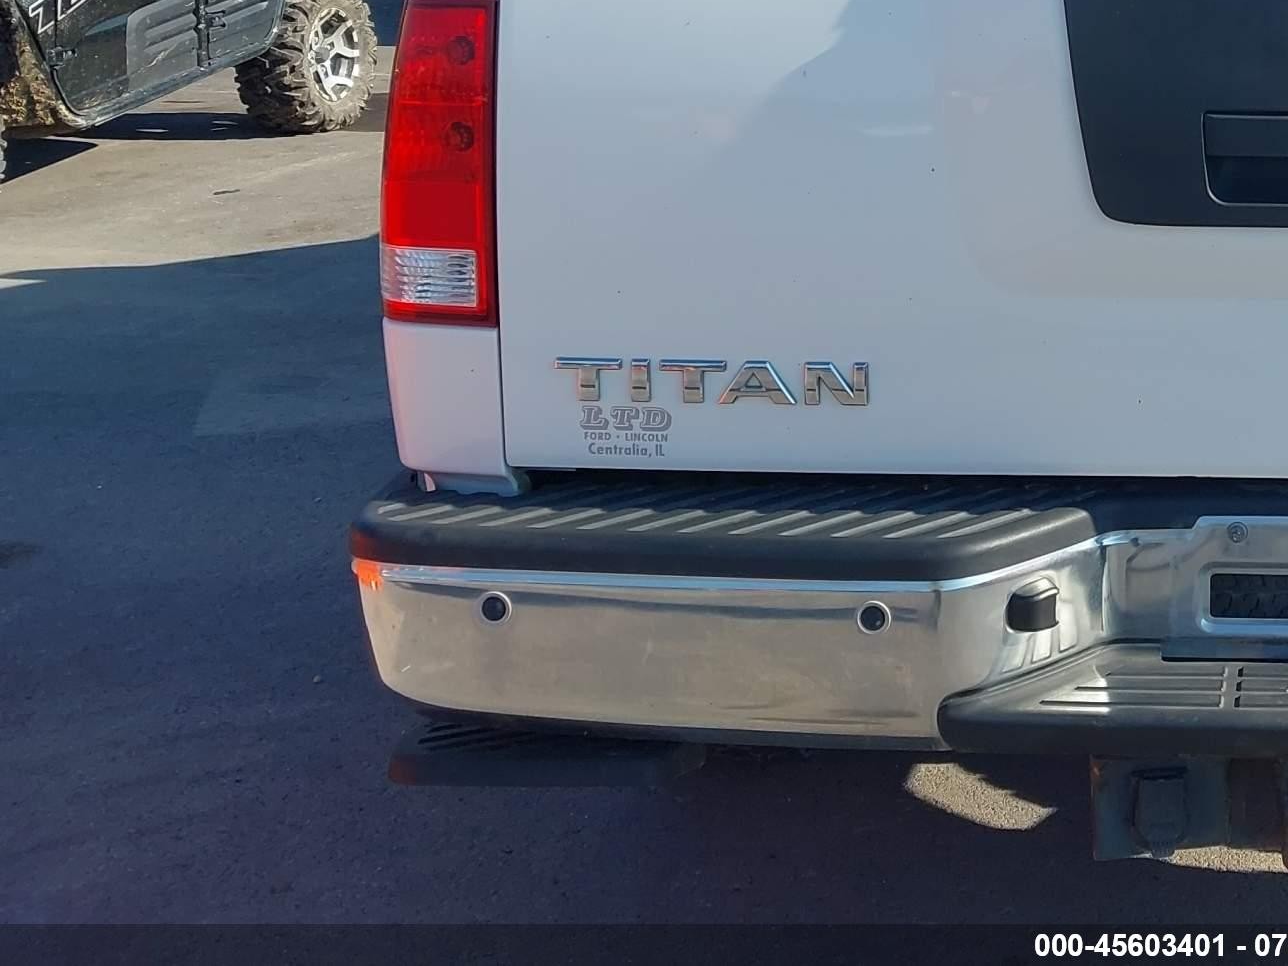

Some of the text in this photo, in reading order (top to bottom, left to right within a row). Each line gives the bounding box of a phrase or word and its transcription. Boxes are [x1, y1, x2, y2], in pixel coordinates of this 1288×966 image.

[554, 356, 869, 406] TITAN
[580, 405, 672, 431] LTD
[584, 432, 668, 442] FORD LINCOLN
[588, 442, 665, 457] Centralia, IL
